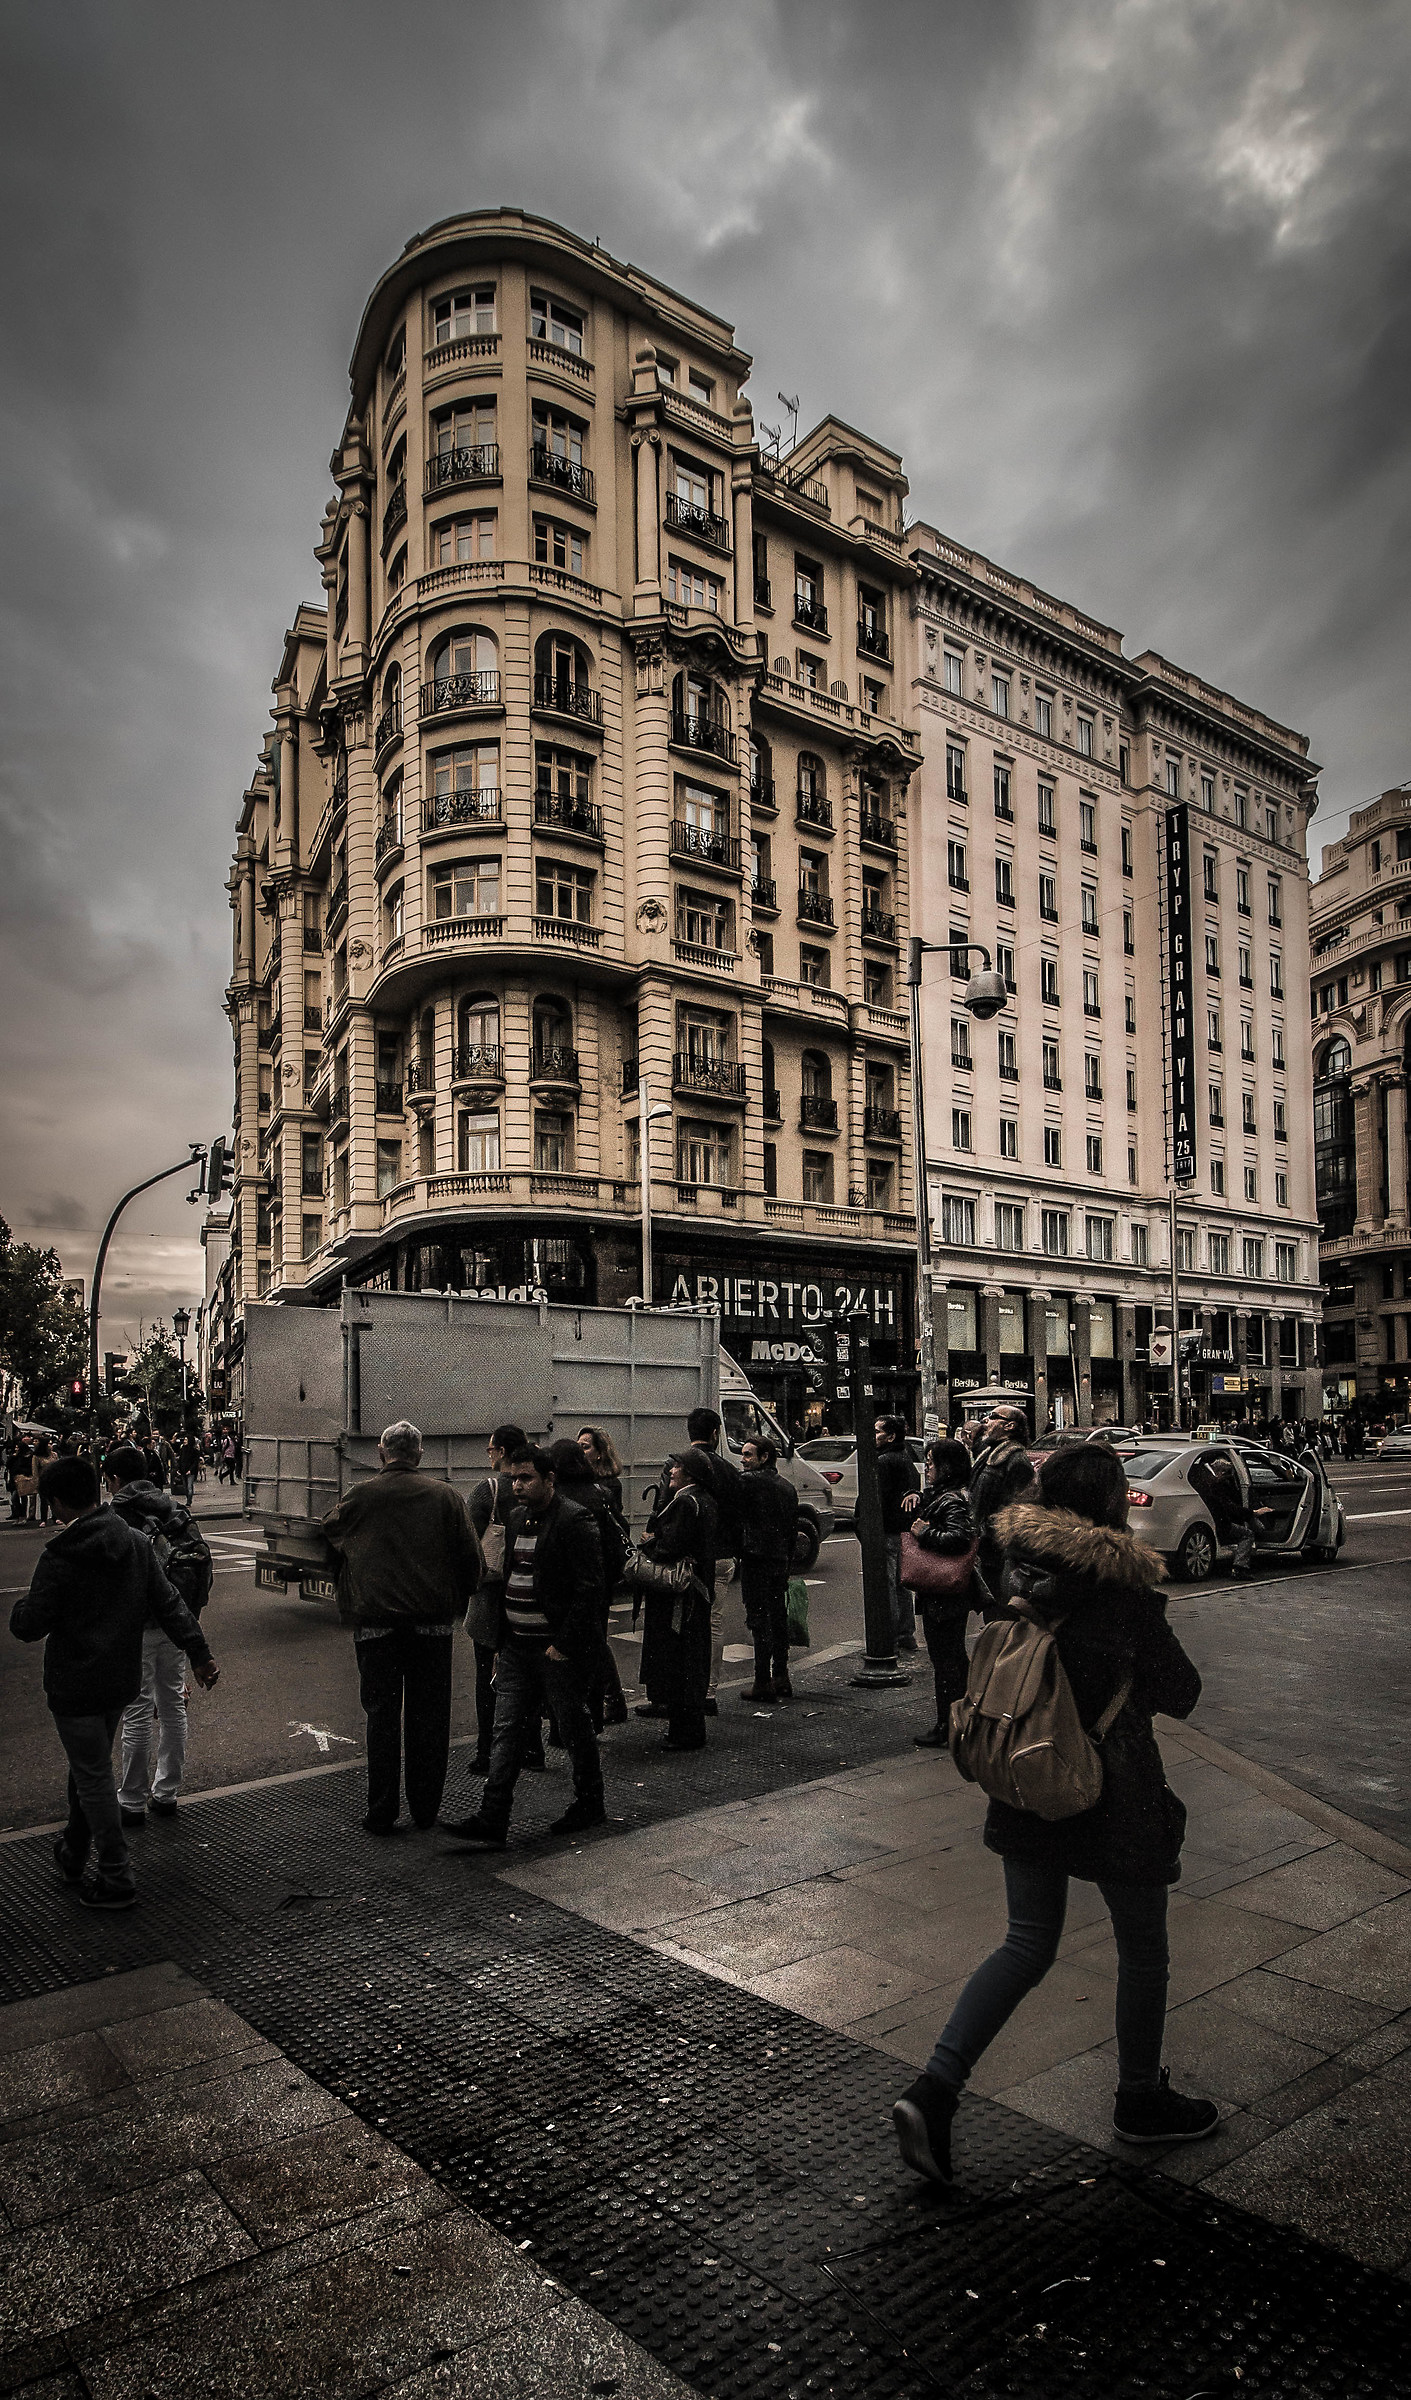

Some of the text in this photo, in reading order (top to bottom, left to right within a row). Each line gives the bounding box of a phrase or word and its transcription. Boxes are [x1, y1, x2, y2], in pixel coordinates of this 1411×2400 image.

[1172, 814, 1182, 915] TRYP
[1174, 934, 1185, 1038] GRAN
[1177, 1140, 1190, 1156] 25
[671, 1274, 824, 1321] ABIERTO
[947, 1302, 965, 1311] Bershka
[953, 1378, 980, 1388] Bershka
[1004, 1379, 1029, 1390] Bershka
